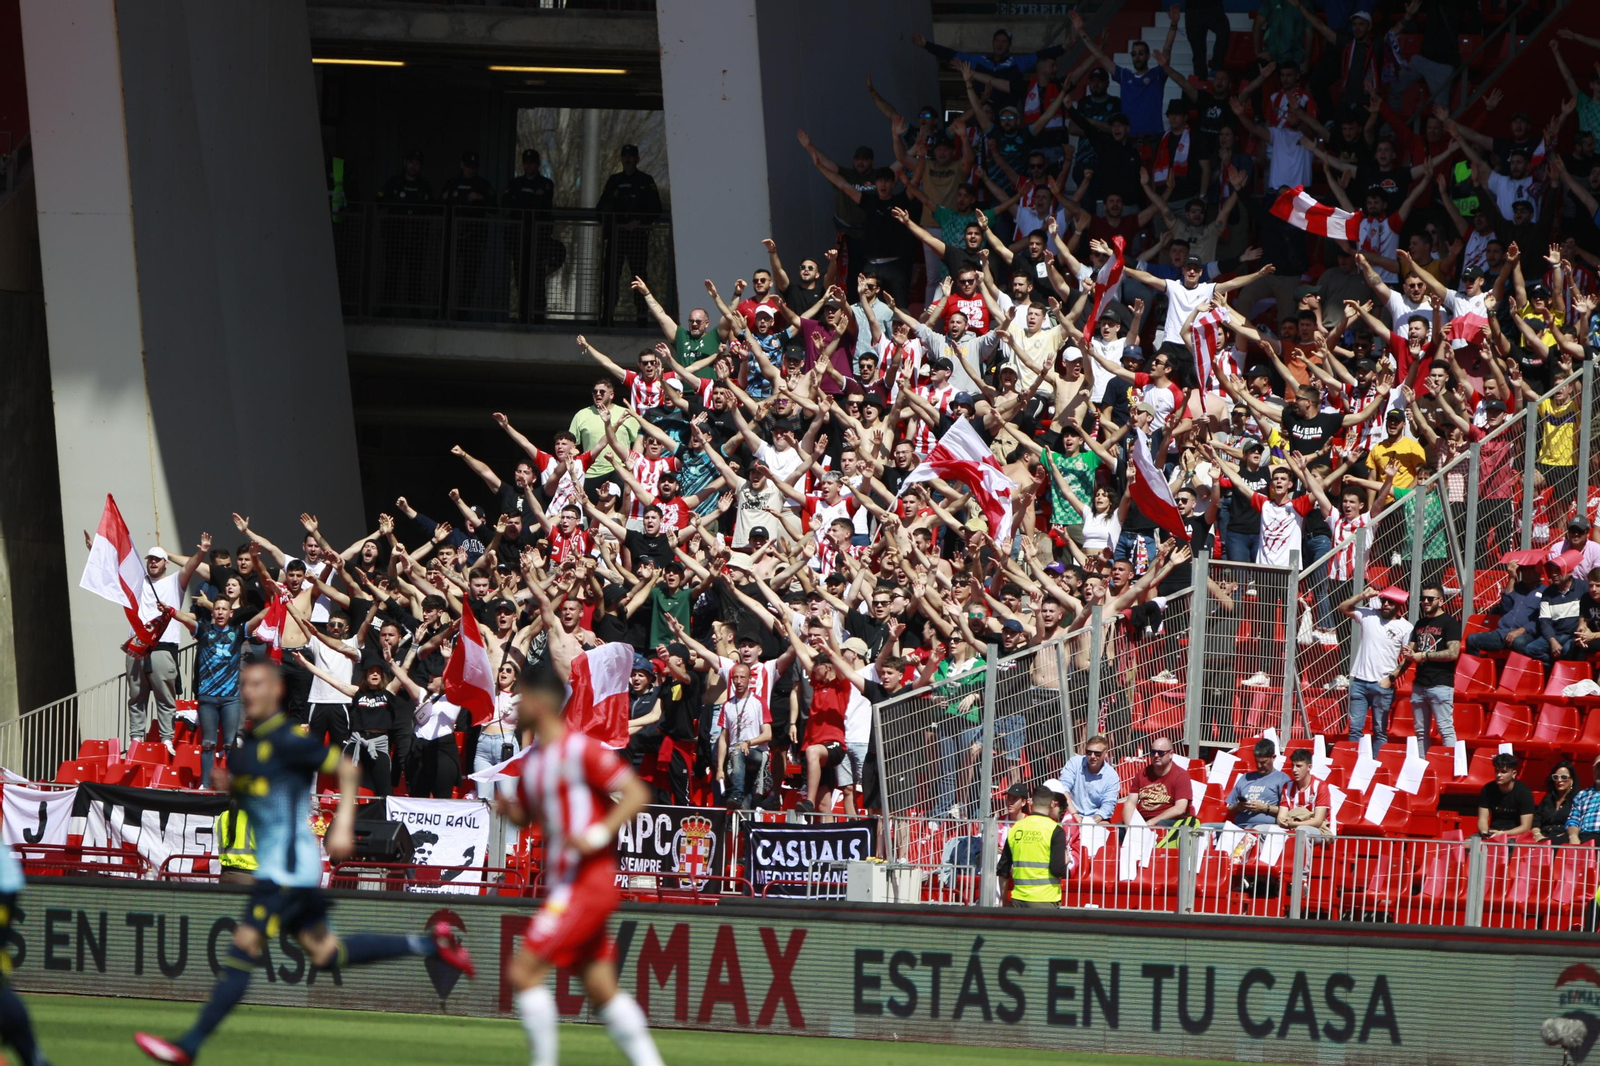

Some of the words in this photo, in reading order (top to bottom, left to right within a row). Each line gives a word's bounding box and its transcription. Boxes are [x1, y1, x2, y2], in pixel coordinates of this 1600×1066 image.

[391, 811, 441, 826] ETERNO
[445, 813, 480, 829] RAÚL
[756, 839, 861, 867] CASUALS
[756, 869, 848, 886] MEDITERRANE
[45, 908, 107, 972] EN
[126, 912, 188, 978] TU
[853, 935, 1026, 1024] ESTÁS
[1047, 957, 1120, 1029] EN
[1142, 964, 1215, 1035] TU
[1237, 967, 1402, 1046] CASA
